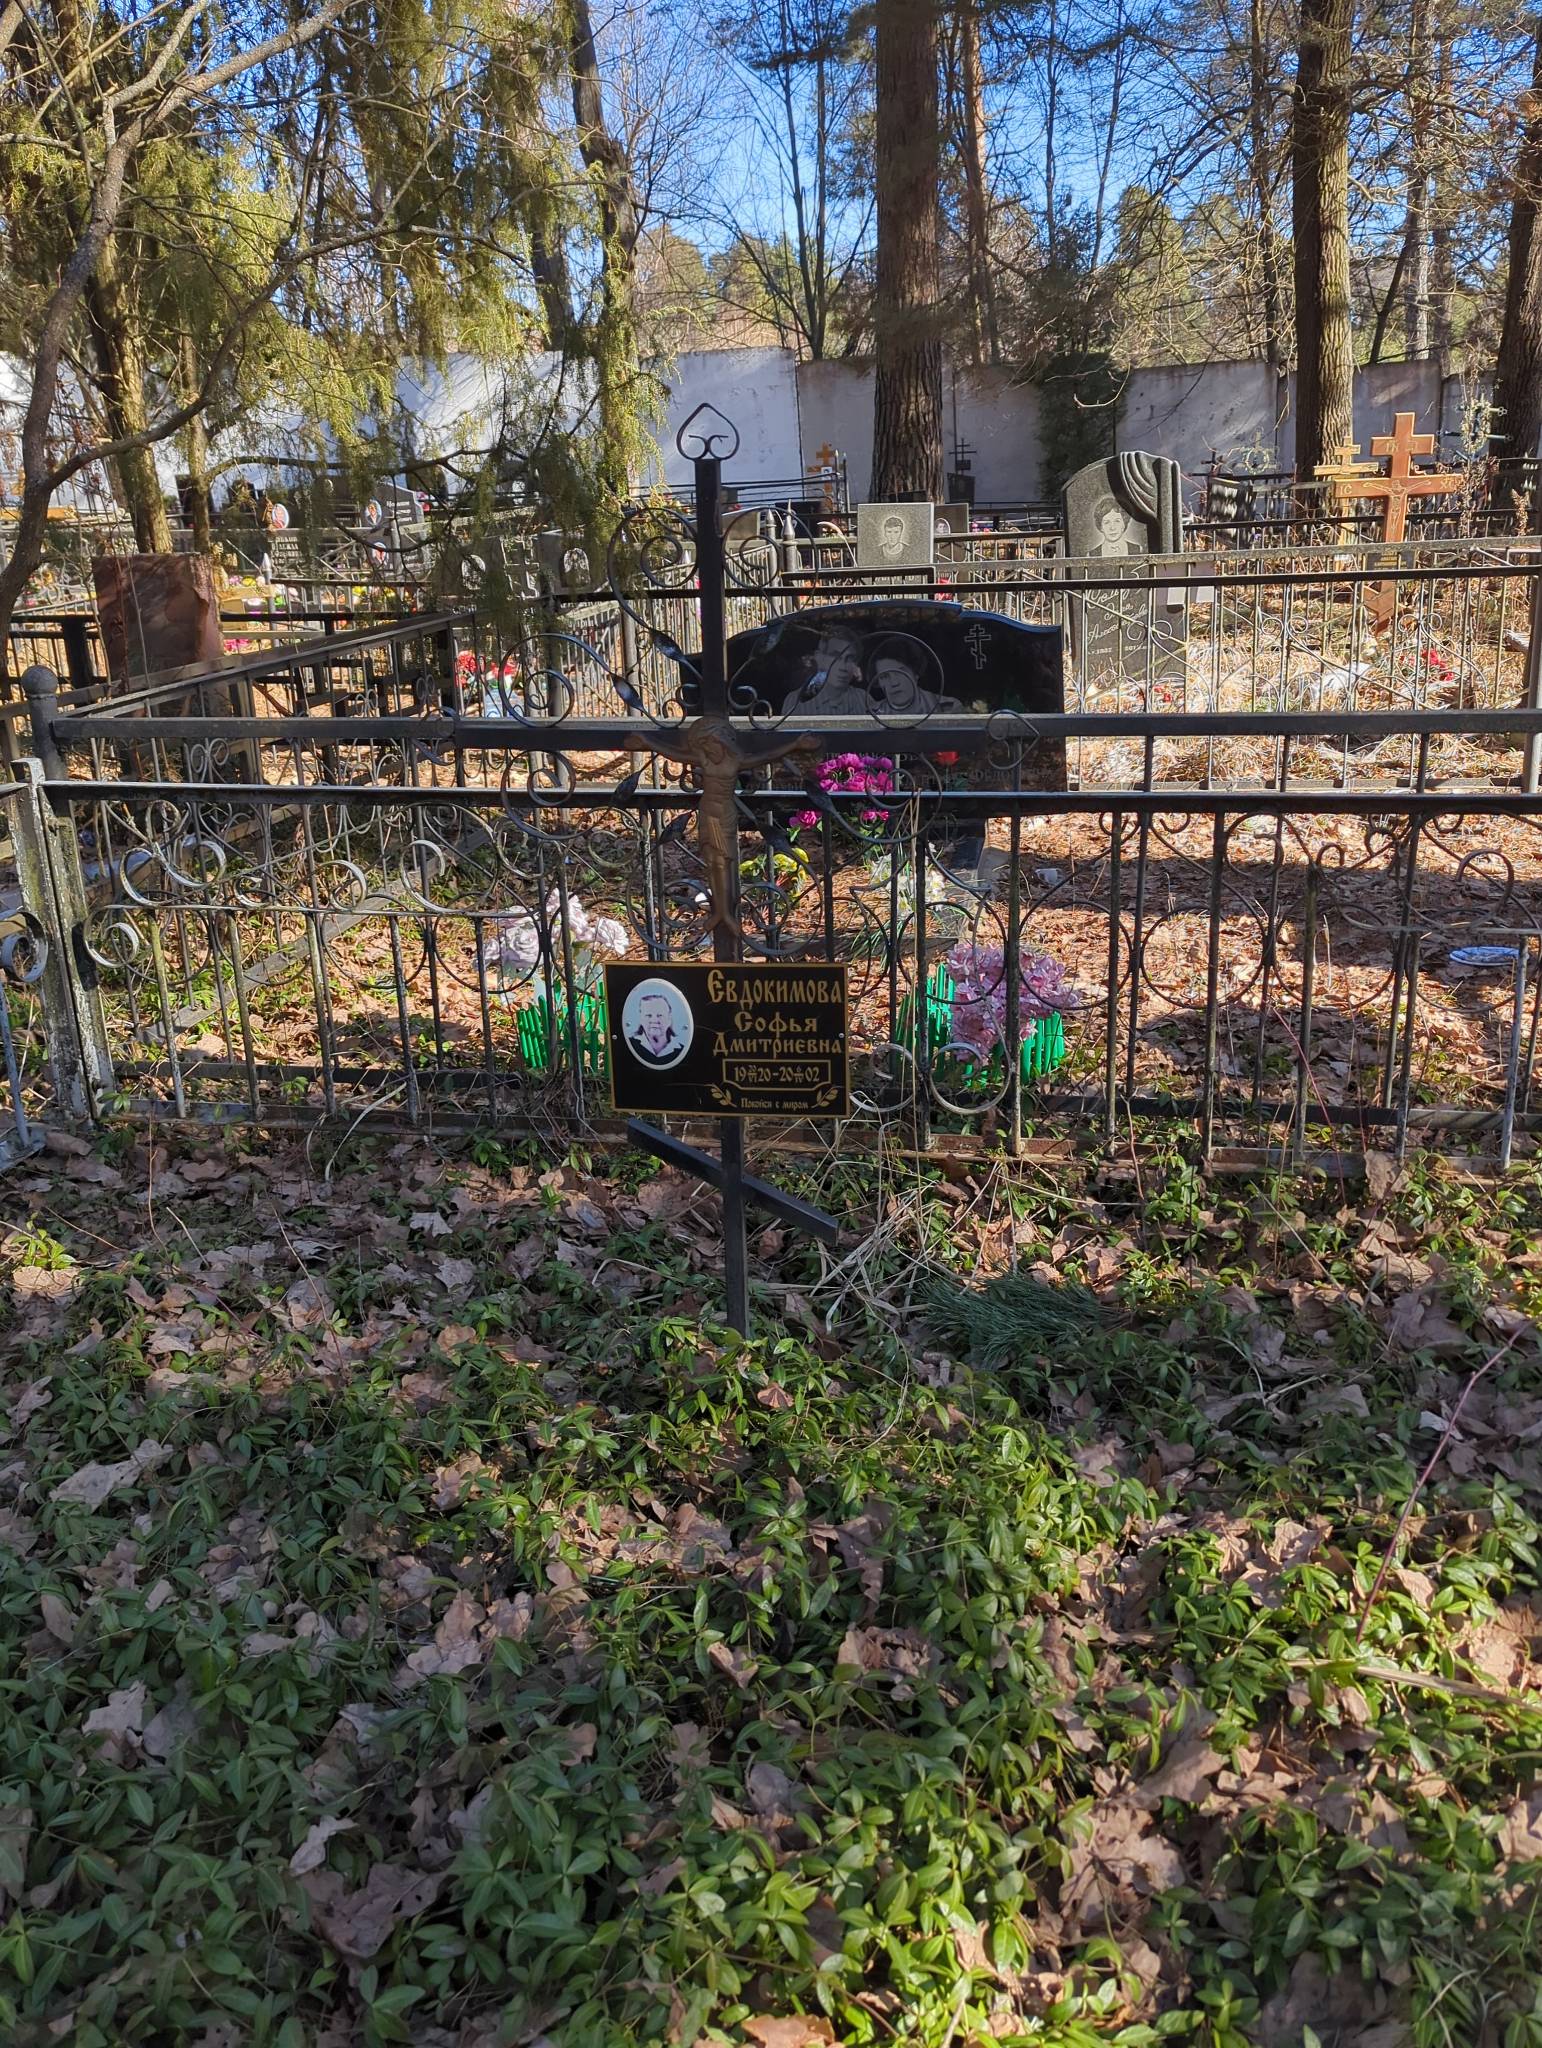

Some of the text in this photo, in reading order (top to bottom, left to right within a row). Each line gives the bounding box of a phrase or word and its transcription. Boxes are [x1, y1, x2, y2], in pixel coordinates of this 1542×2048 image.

[707, 969, 842, 1010] Евдокимова
[734, 1012, 818, 1037] Софья
[712, 1032, 842, 1059] Дмитриевна
